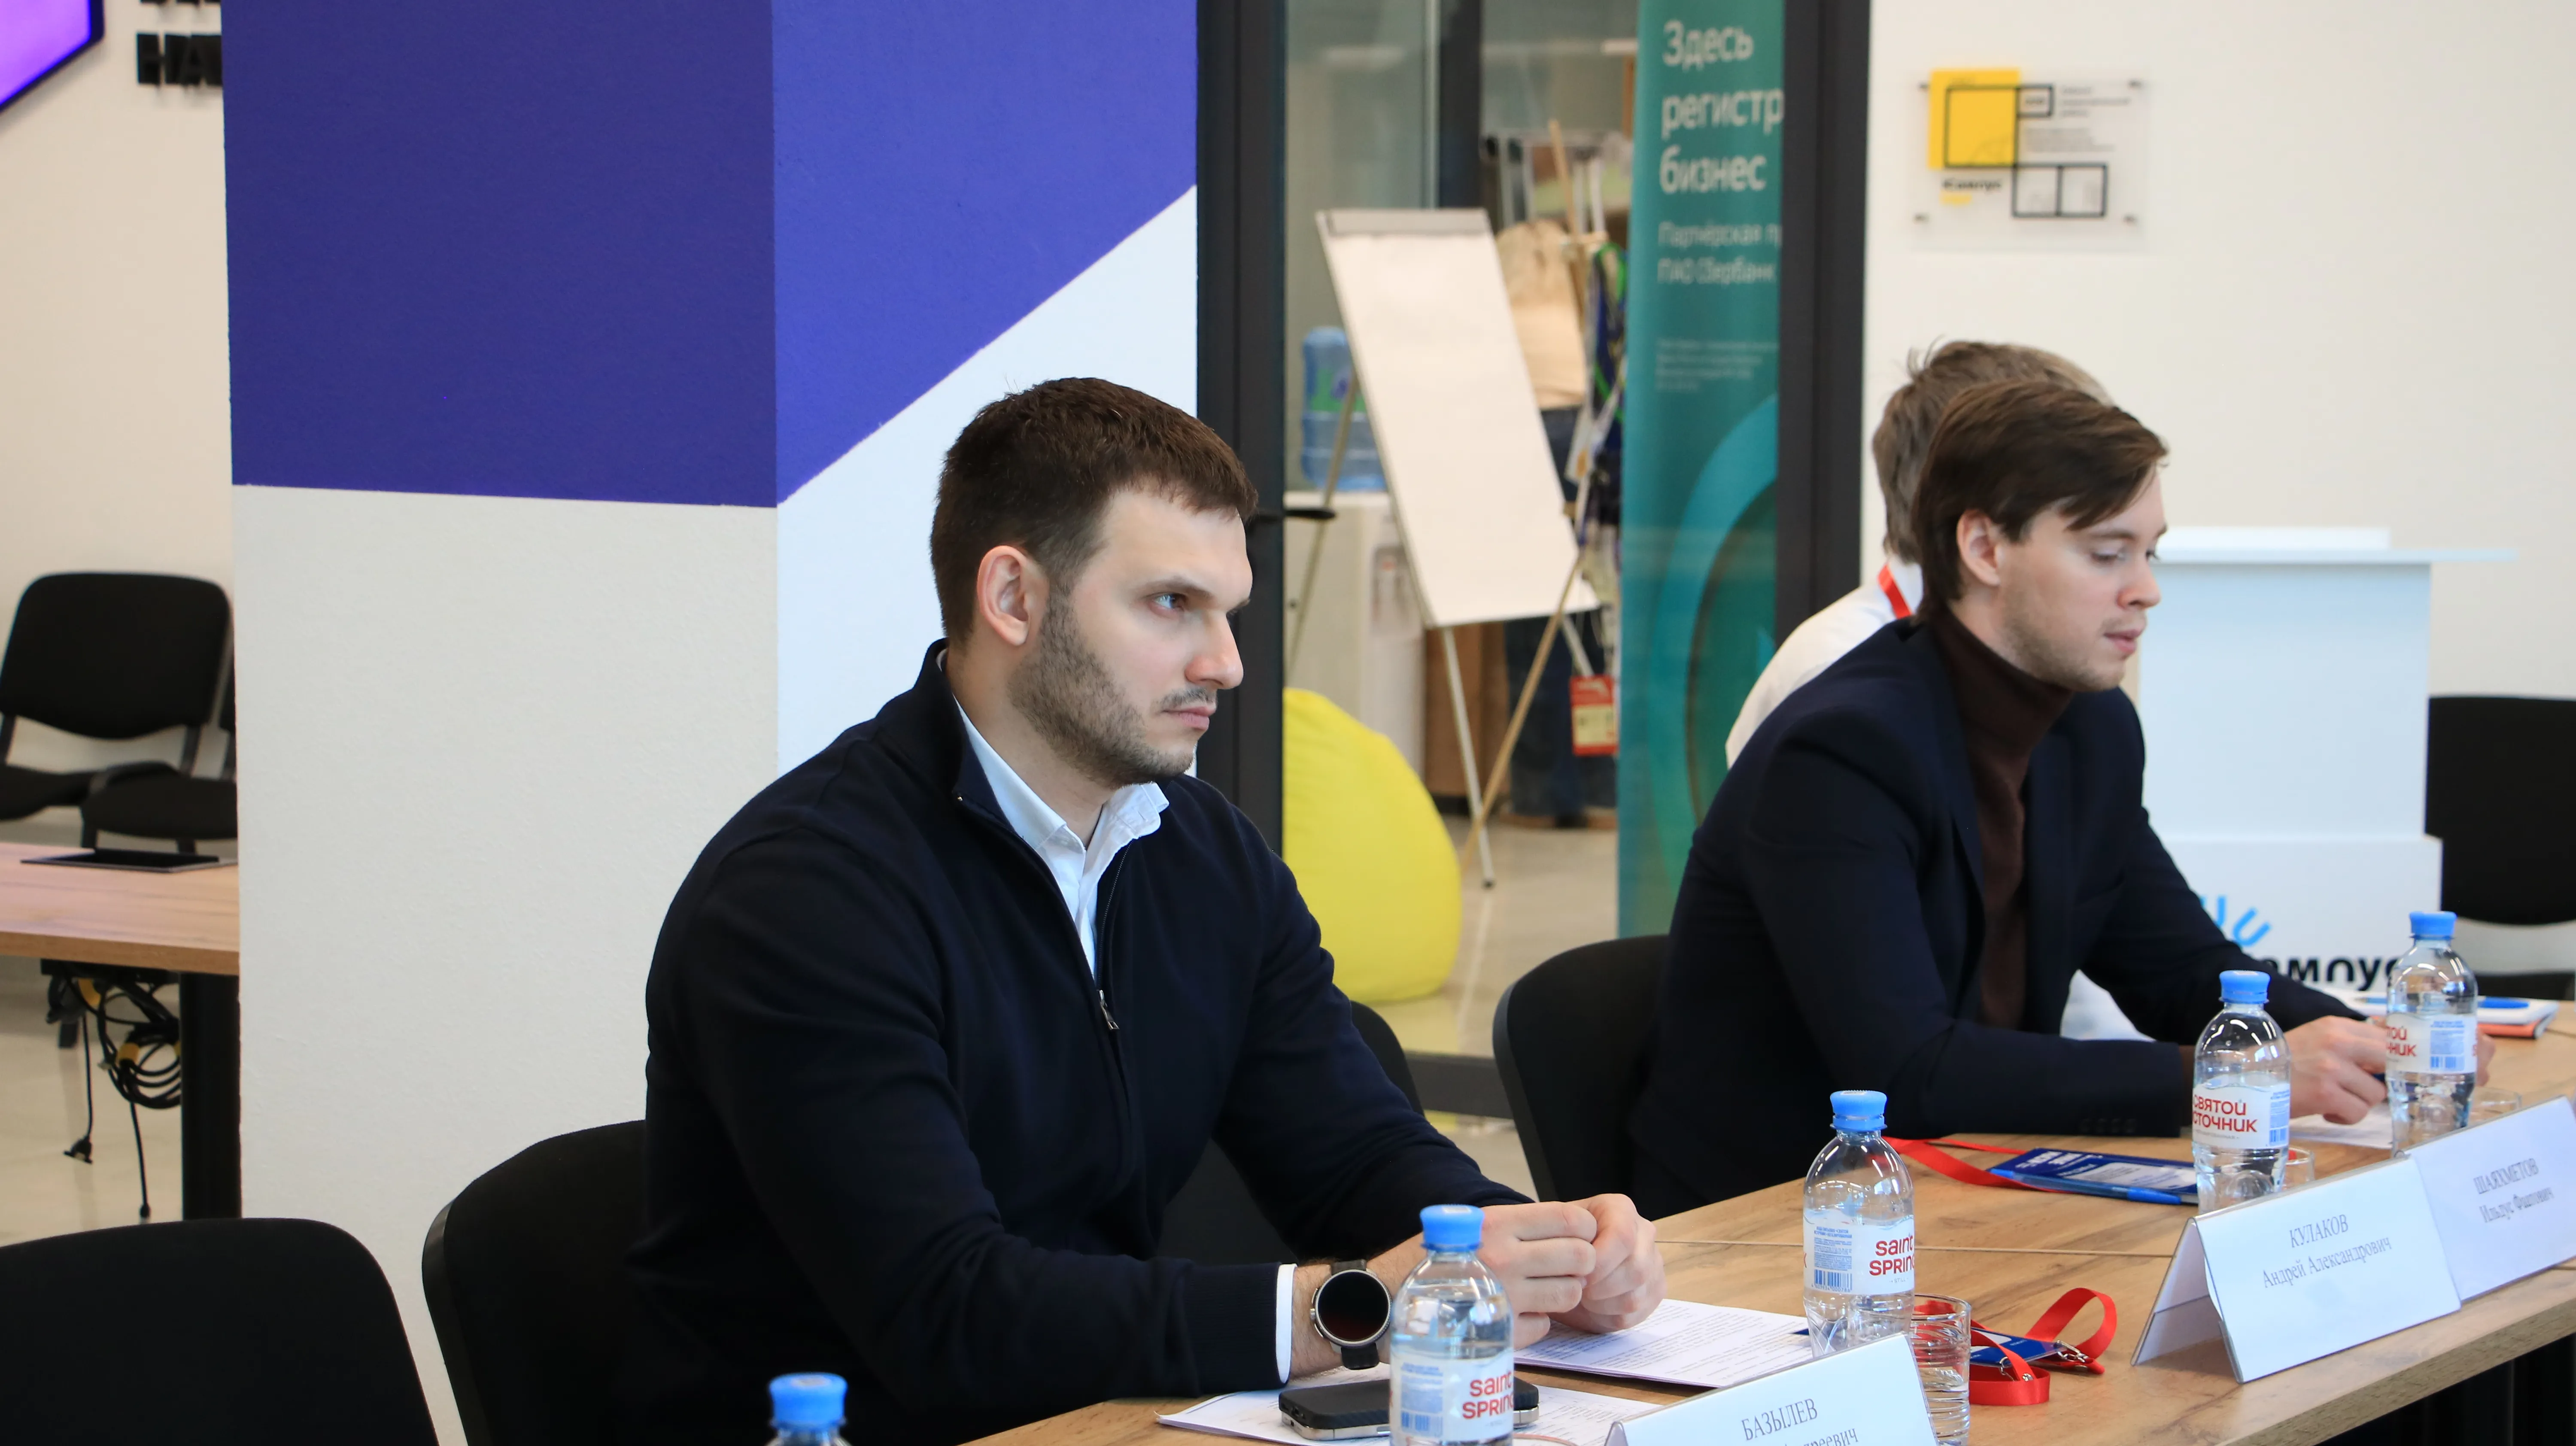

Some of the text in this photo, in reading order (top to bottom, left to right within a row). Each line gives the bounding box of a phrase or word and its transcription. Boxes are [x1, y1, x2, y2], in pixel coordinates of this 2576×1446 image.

[1662, 19, 1754, 71] Здесь
[1661, 88, 1784, 141] регистр
[1659, 144, 1767, 194] бизнес
[2473, 1158, 2539, 1194] ШАЯХМЕТОВ
[2289, 1214, 2349, 1248] КУЛАКОВ
[2263, 1237, 2393, 1288] Андрей Александрович
[1741, 1398, 1818, 1441] БАЗЫЛЕВ
